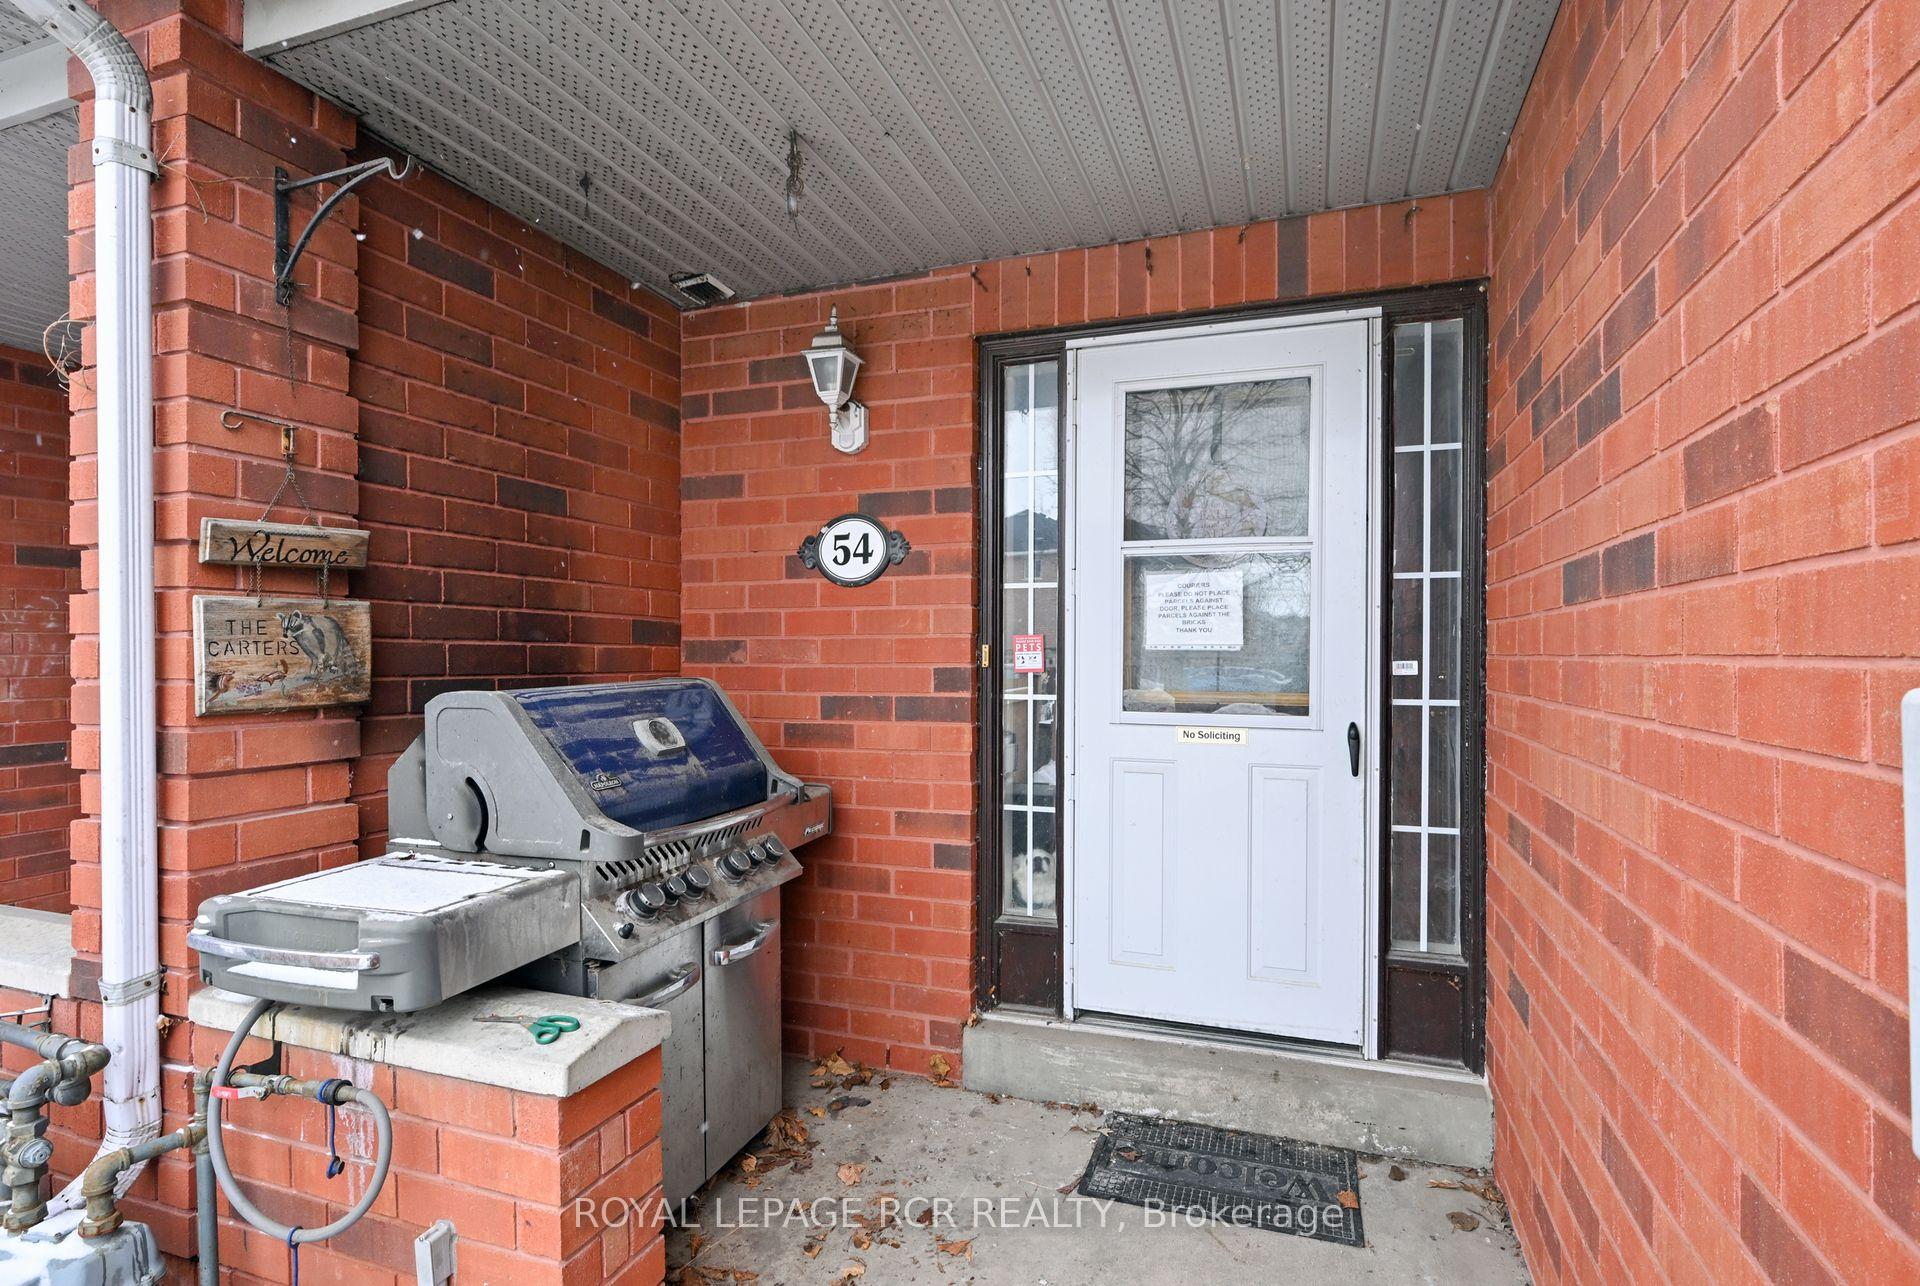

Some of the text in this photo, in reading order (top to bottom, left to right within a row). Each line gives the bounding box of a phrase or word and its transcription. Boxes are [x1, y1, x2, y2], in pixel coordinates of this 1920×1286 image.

[229, 529, 349, 565] Welcome
[832, 532, 874, 566] 54
[225, 619, 268, 636] THE
[208, 640, 300, 657] CARTERS
[1015, 643, 1042, 652] PETS
[1182, 730, 1241, 742] No Soliciting
